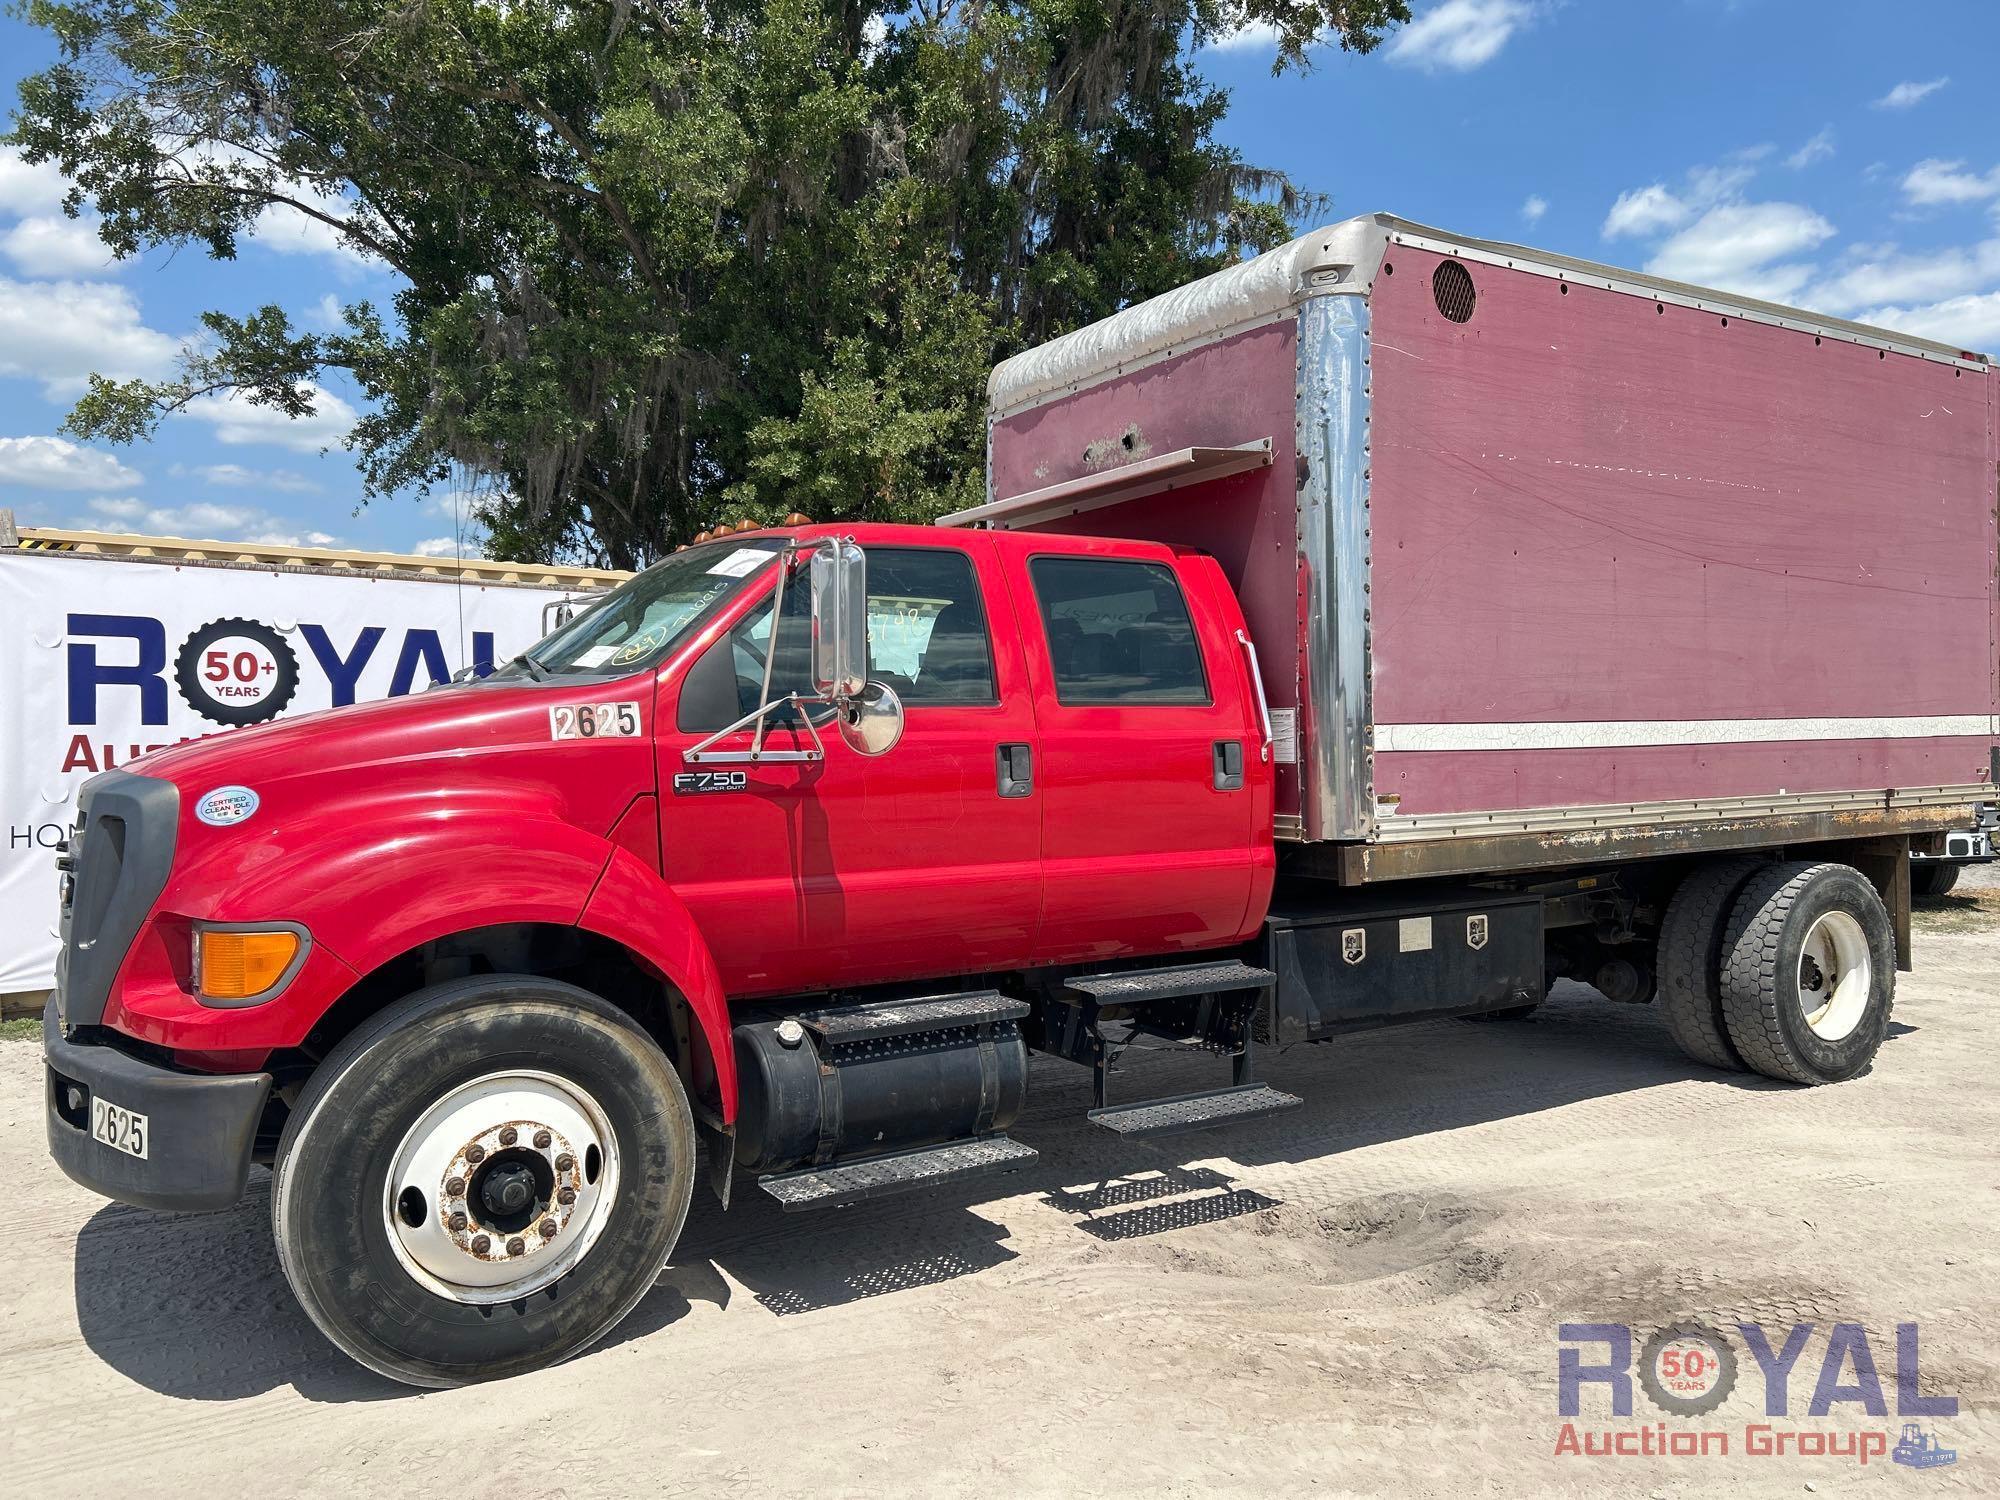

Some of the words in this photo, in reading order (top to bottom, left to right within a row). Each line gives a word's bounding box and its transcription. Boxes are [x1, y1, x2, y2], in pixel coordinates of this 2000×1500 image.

[204, 651, 276, 683] 50+
[215, 686, 261, 698] YEARS
[556, 704, 636, 738] 2625
[204, 805, 231, 815] CLEAN
[233, 801, 251, 809] IDLE
[207, 796, 247, 808] CERTIFIED
[96, 1101, 143, 1155] 2625
